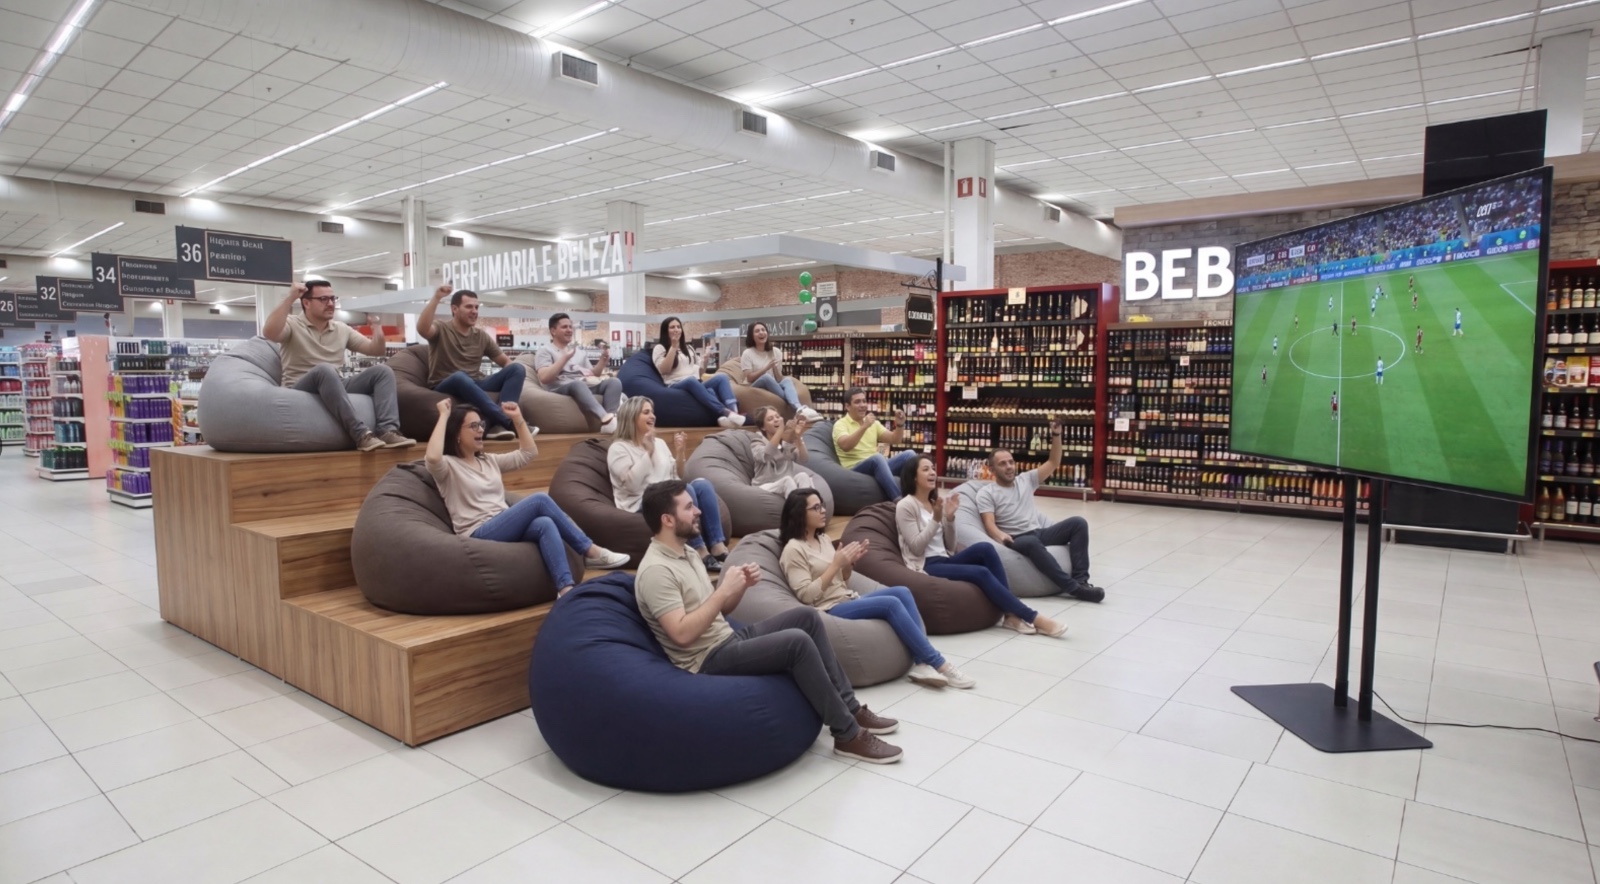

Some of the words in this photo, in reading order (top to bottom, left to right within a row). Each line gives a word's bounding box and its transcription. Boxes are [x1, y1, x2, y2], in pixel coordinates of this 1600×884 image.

[181, 242, 202, 263] 36
[442, 247, 539, 293] PERFUMARIA
[543, 245, 552, 282] E
[558, 233, 624, 280] BELEZA
[95, 266, 117, 284] 34
[1125, 246, 1235, 302] BEB
[40, 286, 57, 301] 32
